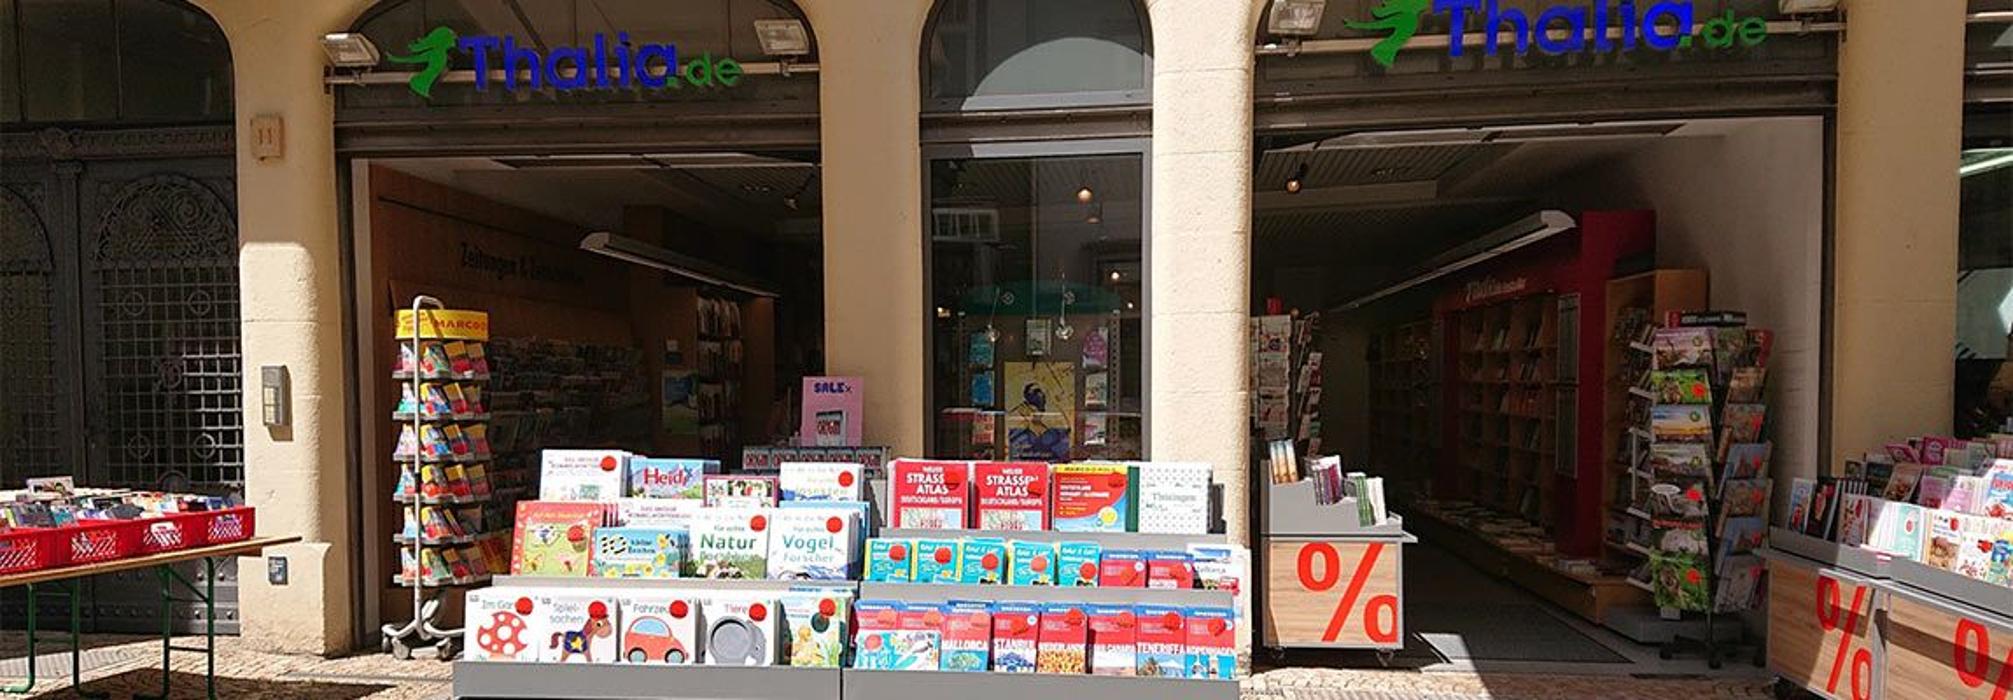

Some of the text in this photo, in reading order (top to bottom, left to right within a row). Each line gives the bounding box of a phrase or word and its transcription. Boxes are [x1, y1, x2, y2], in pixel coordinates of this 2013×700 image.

[1432, 0, 1768, 58] Thalia.de
[457, 31, 742, 92] Thalia.de
[906, 472, 945, 484] STRASS
[916, 485, 949, 495] ATLAS
[995, 486, 1029, 497] ATLAS
[700, 533, 756, 550] Natur
[782, 535, 835, 554] Vogel
[1297, 542, 1398, 643] %
[482, 600, 495, 609] Im
[1816, 575, 1872, 700] %
